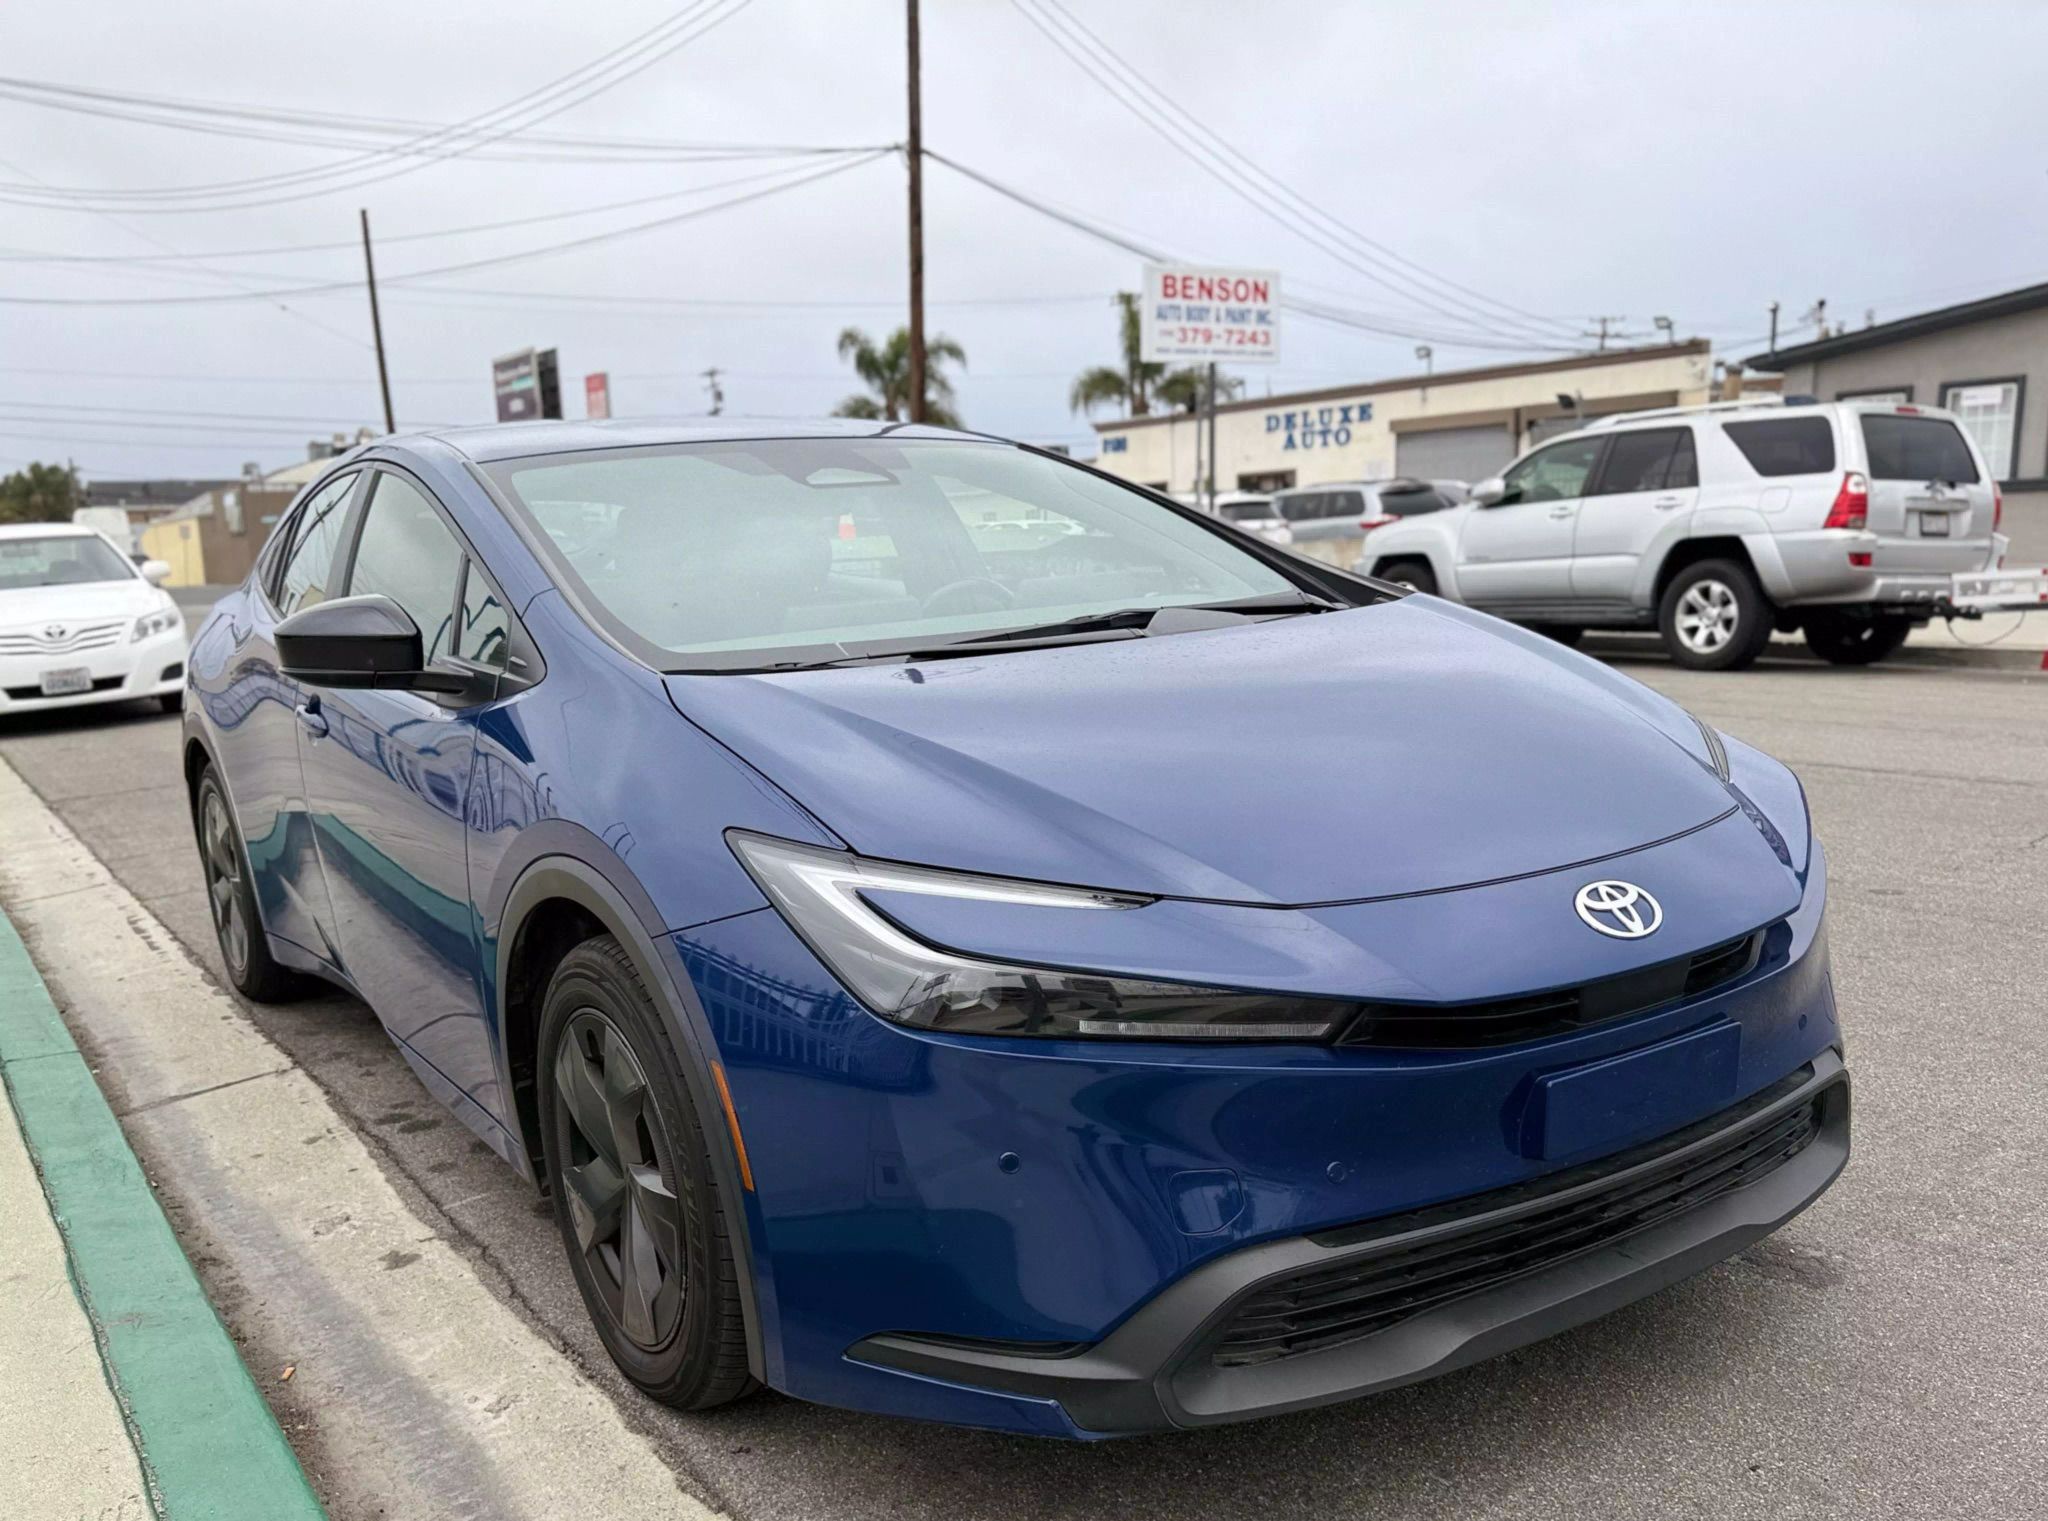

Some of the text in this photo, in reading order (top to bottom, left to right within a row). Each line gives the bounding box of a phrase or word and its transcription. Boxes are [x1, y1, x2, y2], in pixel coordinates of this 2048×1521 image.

[1162, 274, 1269, 303] BENSON
[1178, 327, 1271, 346] 379-7243
[1265, 402, 1374, 433] DELUXE
[1283, 427, 1352, 450] AUTO
